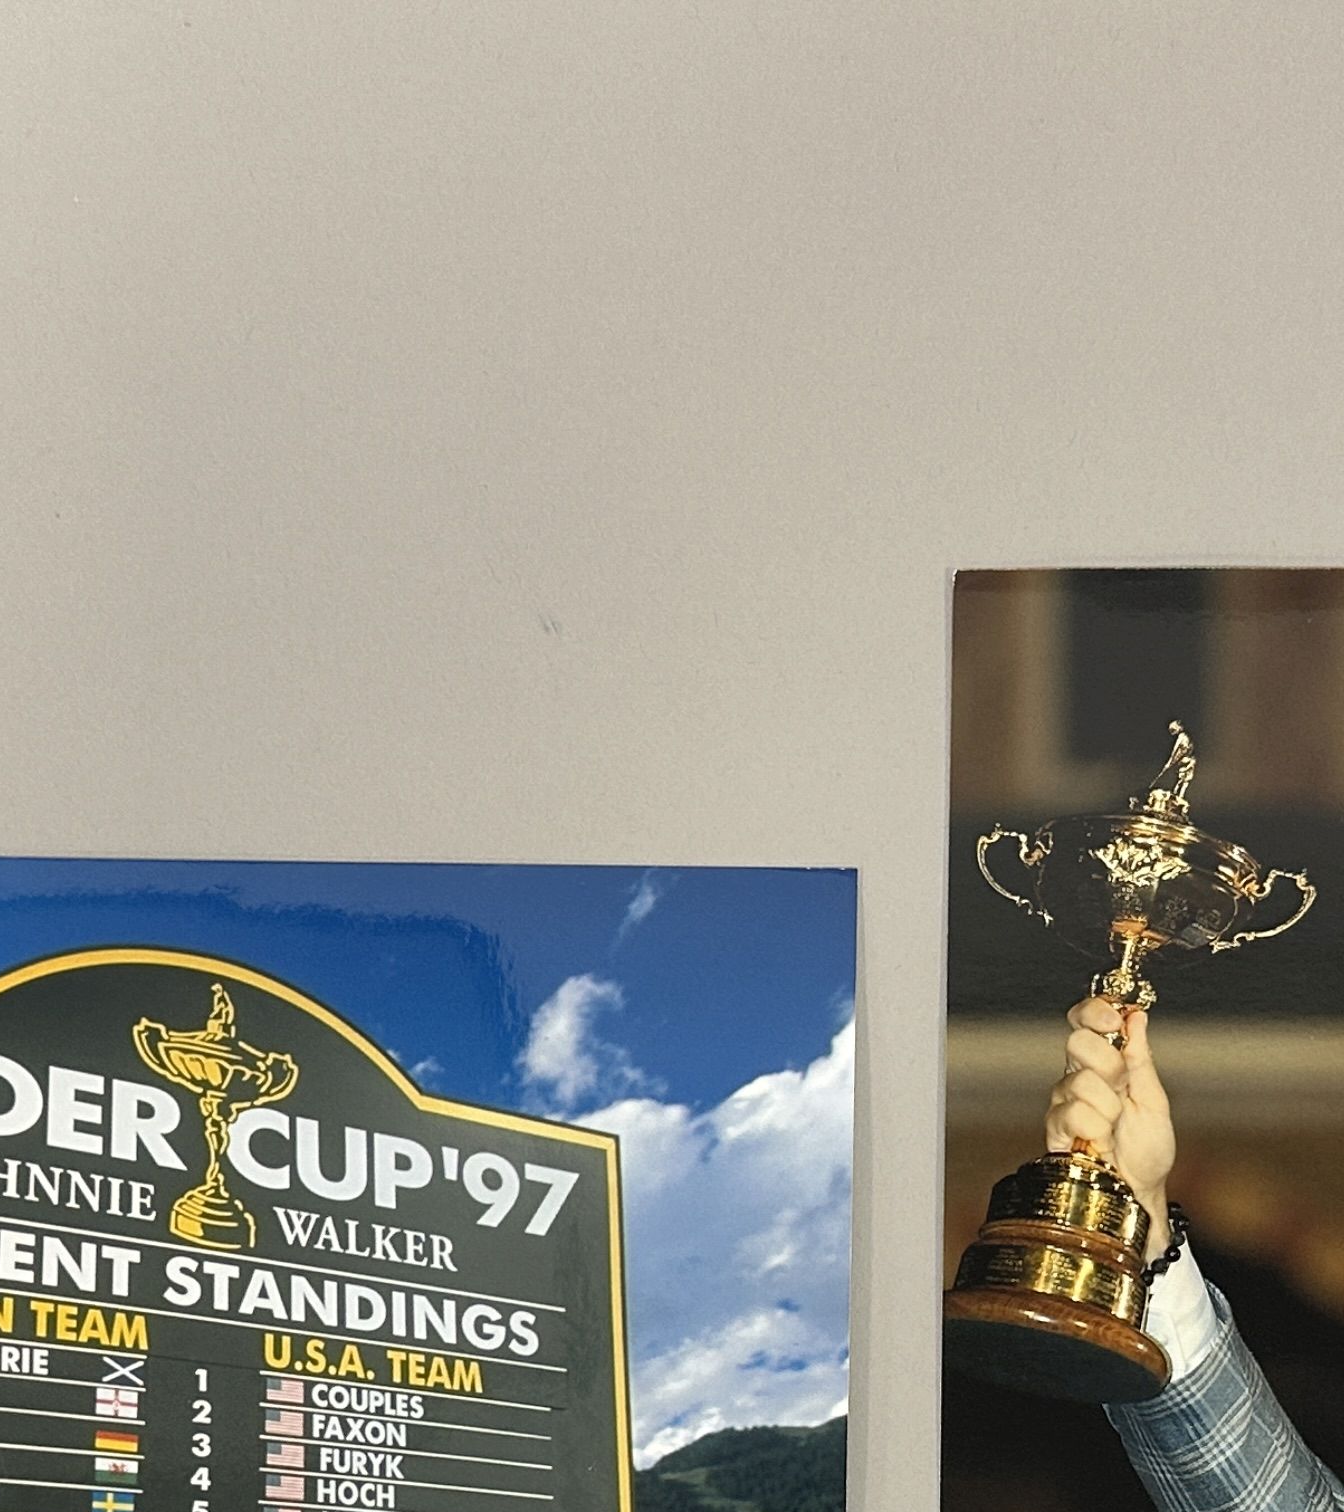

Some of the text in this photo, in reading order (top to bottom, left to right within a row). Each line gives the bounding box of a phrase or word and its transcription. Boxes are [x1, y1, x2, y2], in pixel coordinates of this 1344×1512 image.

[274, 1207, 458, 1273] WALKER
[163, 1256, 539, 1356] STANDINGS
[30, 1301, 148, 1351] TEAM
[265, 1333, 482, 1395] U.S.A. TEAM
[195, 1369, 207, 1392] 1
[192, 1400, 211, 1424] 2
[312, 1384, 424, 1418] COUPLES
[192, 1433, 211, 1457] 3
[313, 1414, 406, 1447] FAXON
[190, 1467, 211, 1490] 4
[320, 1447, 404, 1479] FURYK
[317, 1479, 394, 1508] HOCH
